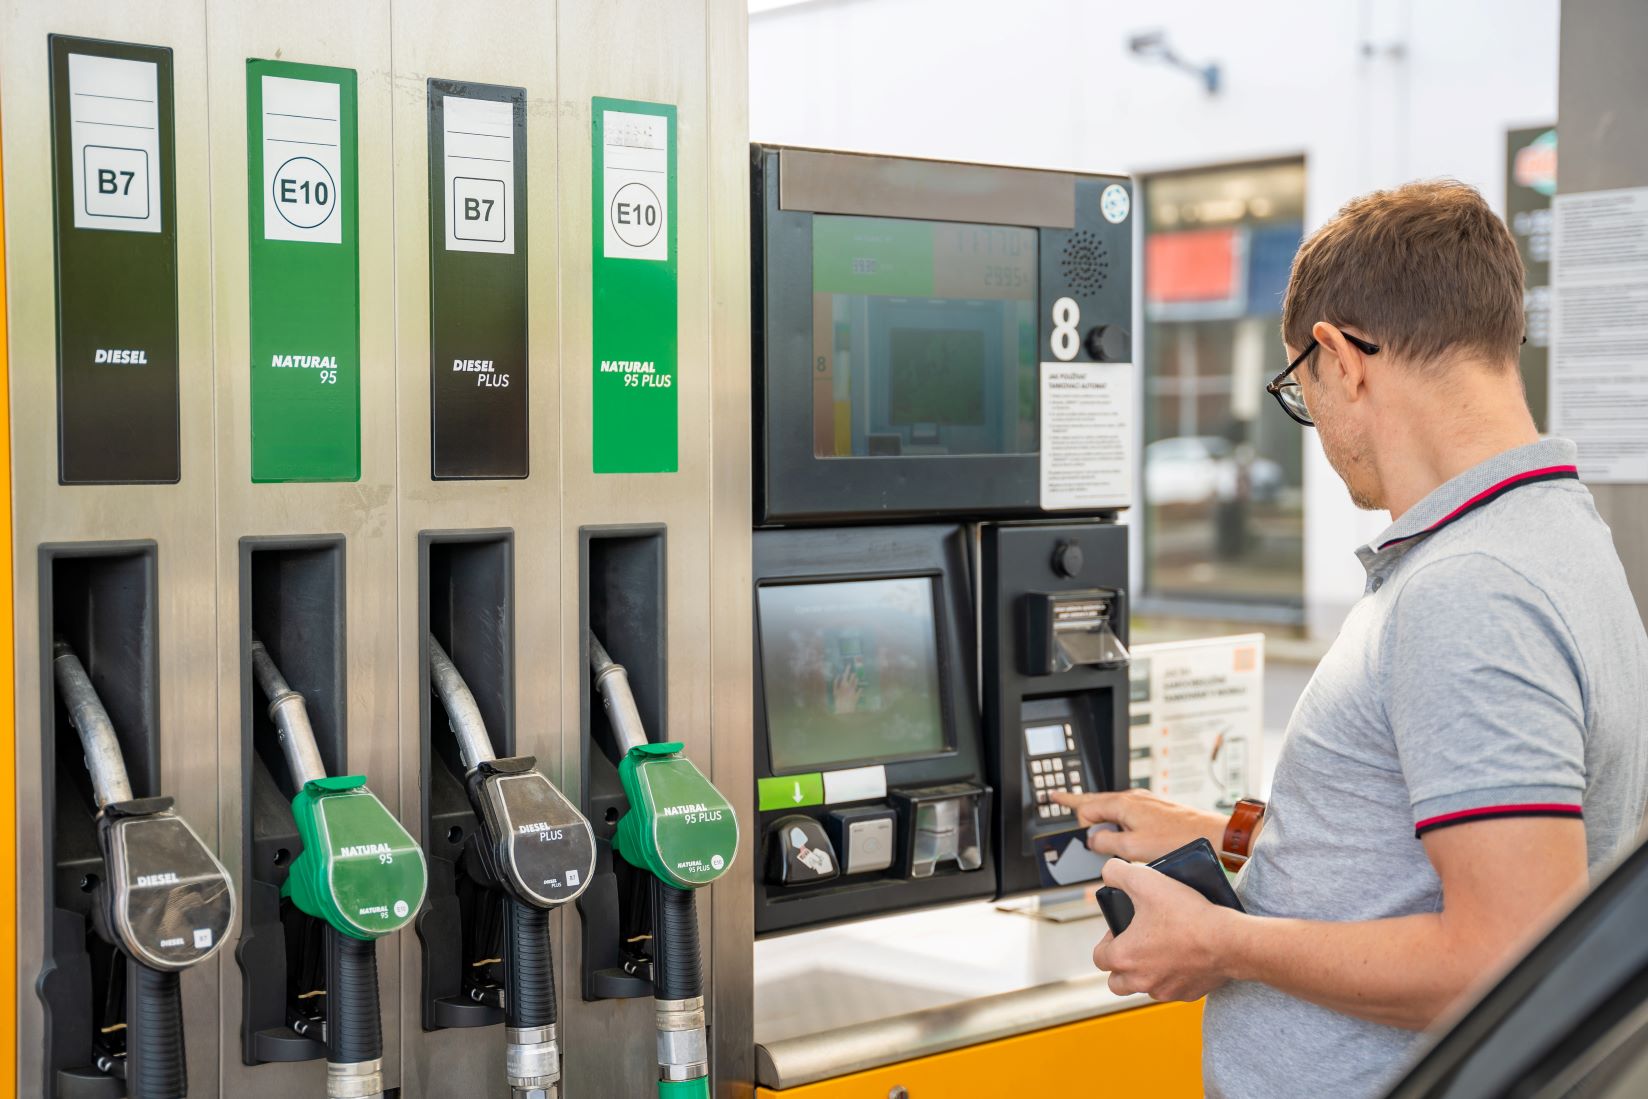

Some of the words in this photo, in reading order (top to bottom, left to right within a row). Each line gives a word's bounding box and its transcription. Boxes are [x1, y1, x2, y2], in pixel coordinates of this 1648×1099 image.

[98, 168, 135, 196] B7
[280, 178, 328, 206] E10
[464, 197, 495, 222] B7
[617, 202, 656, 227] E10
[1050, 297, 1080, 361] 8
[95, 349, 147, 365] DIESEL
[271, 354, 337, 369] NATURAL
[453, 359, 495, 373] DIESEL
[600, 360, 656, 373] NATURAL
[319, 370, 337, 385] 95
[477, 373, 510, 387] PLUS
[623, 373, 639, 387] 95
[642, 374, 672, 388] PLUS
[664, 803, 708, 816] NATURAL
[684, 813, 697, 825] 95
[699, 811, 722, 823] PLUS
[518, 821, 551, 834] DIESEL
[540, 830, 563, 842] PLUS
[340, 843, 391, 858] NATURAL
[379, 853, 393, 865] 95
[677, 860, 702, 869] NATURAL
[696, 864, 711, 872] PLUS
[137, 872, 180, 888] DIESEL
[359, 905, 389, 915] NATURAL
[380, 911, 389, 919] 95
[160, 937, 185, 947] DIESEL
